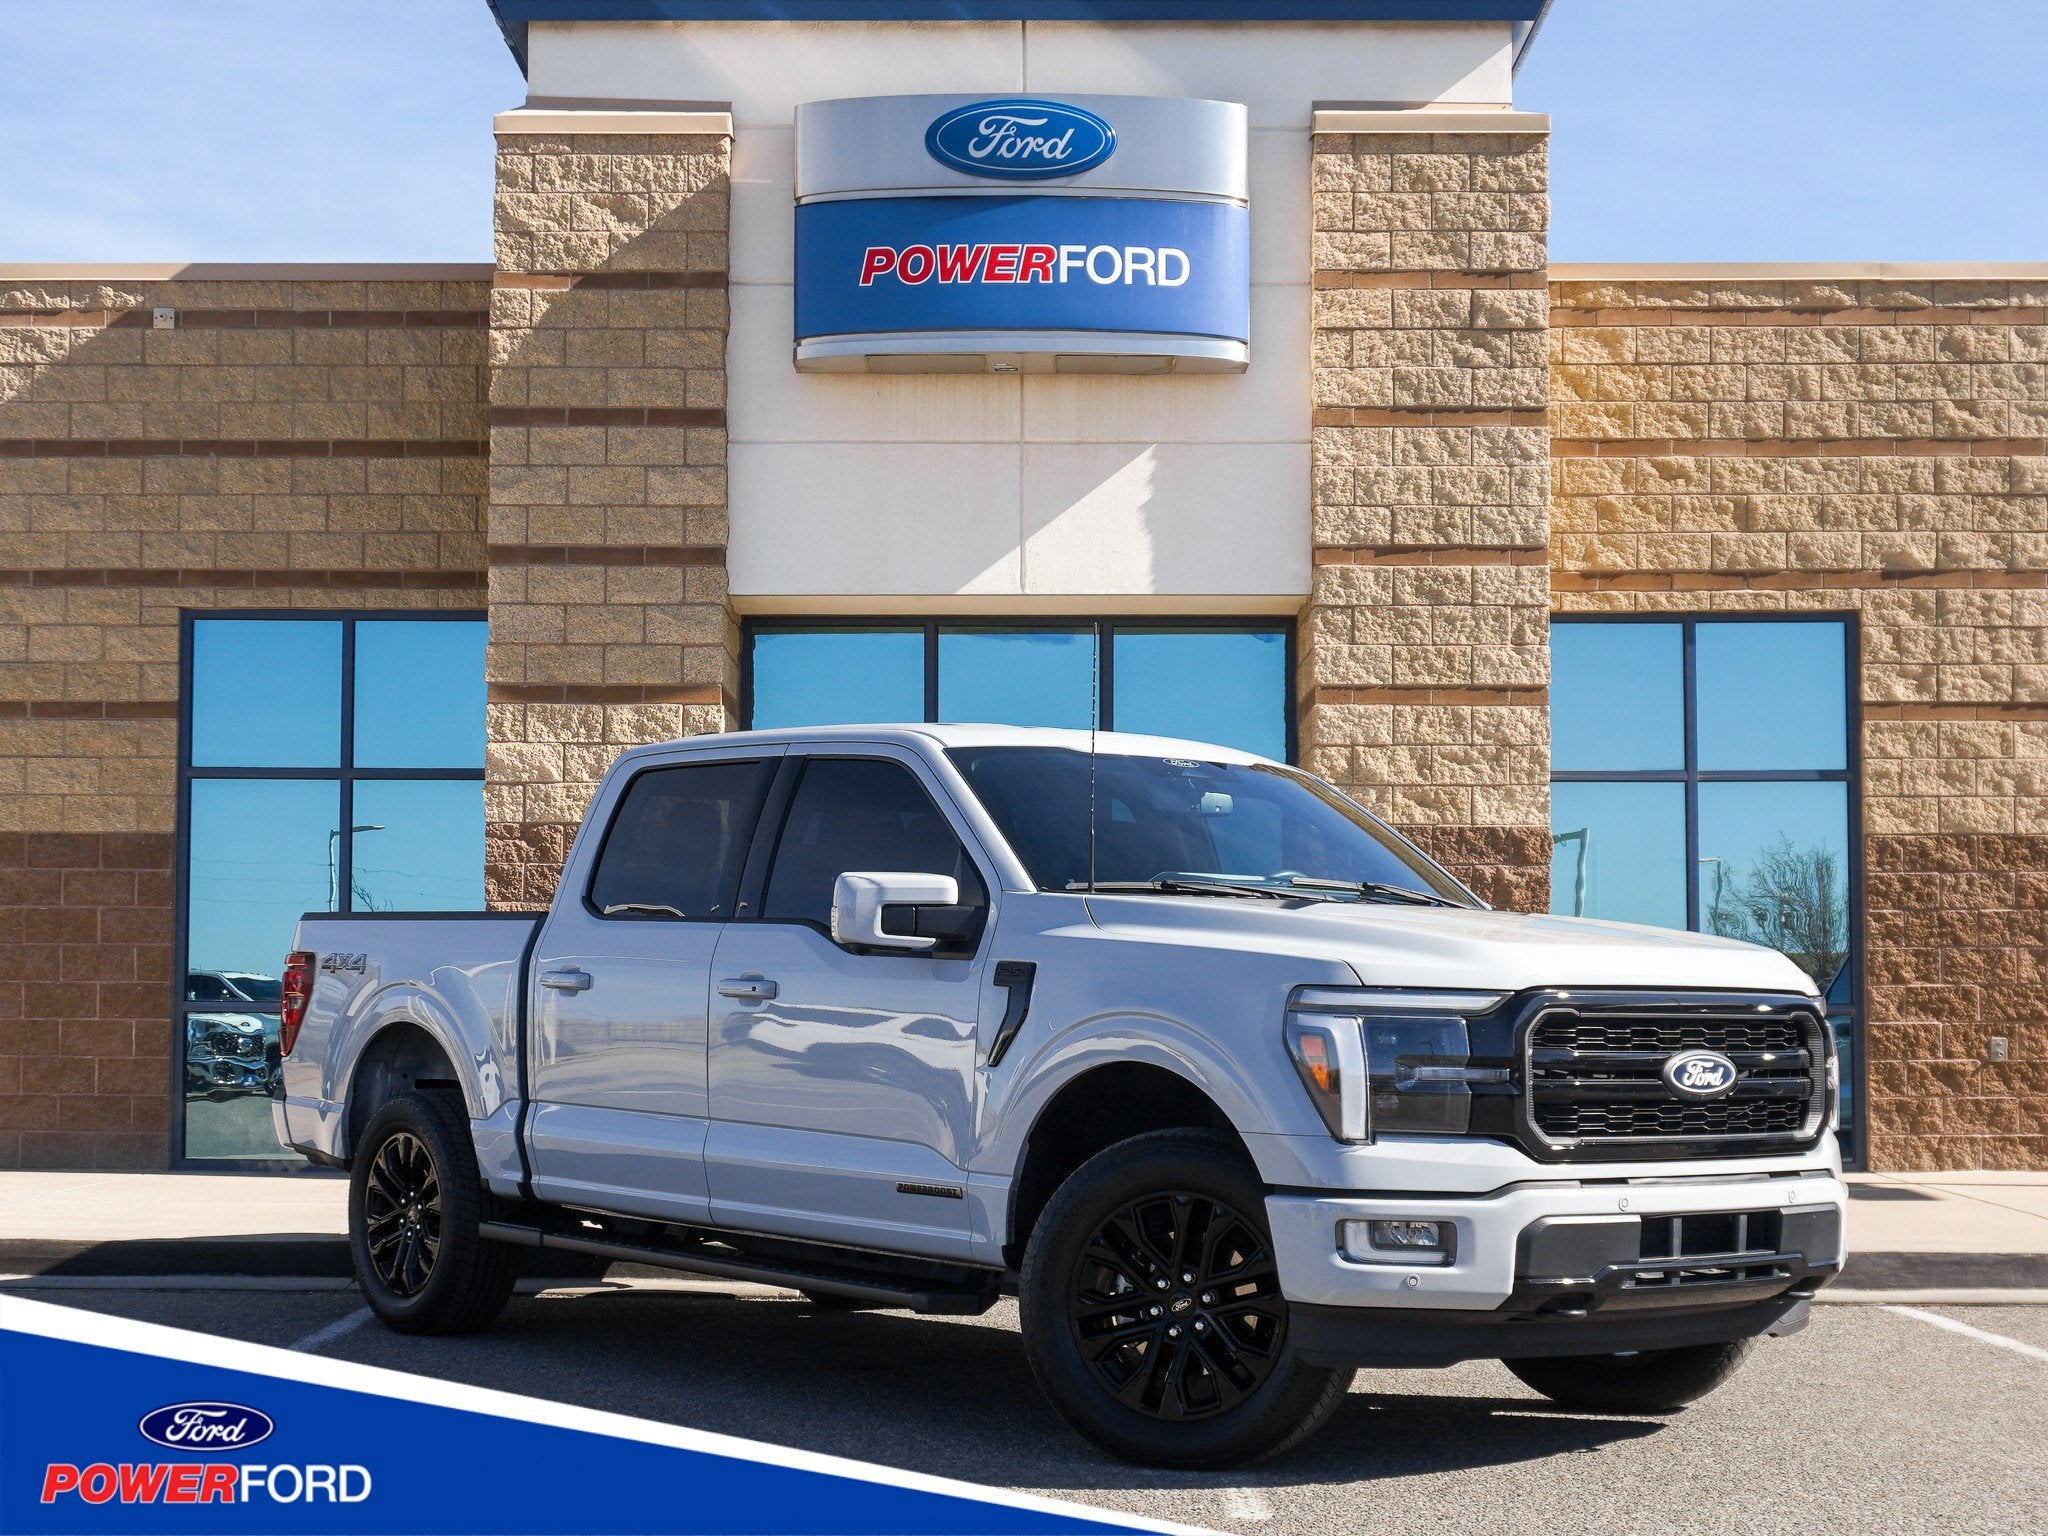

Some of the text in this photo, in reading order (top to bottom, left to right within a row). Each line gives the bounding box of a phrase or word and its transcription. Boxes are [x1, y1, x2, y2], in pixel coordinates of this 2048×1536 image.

[967, 115, 1072, 160] Ford
[858, 243, 1191, 287] POWERFORD
[1682, 1060, 1724, 1087] Ford
